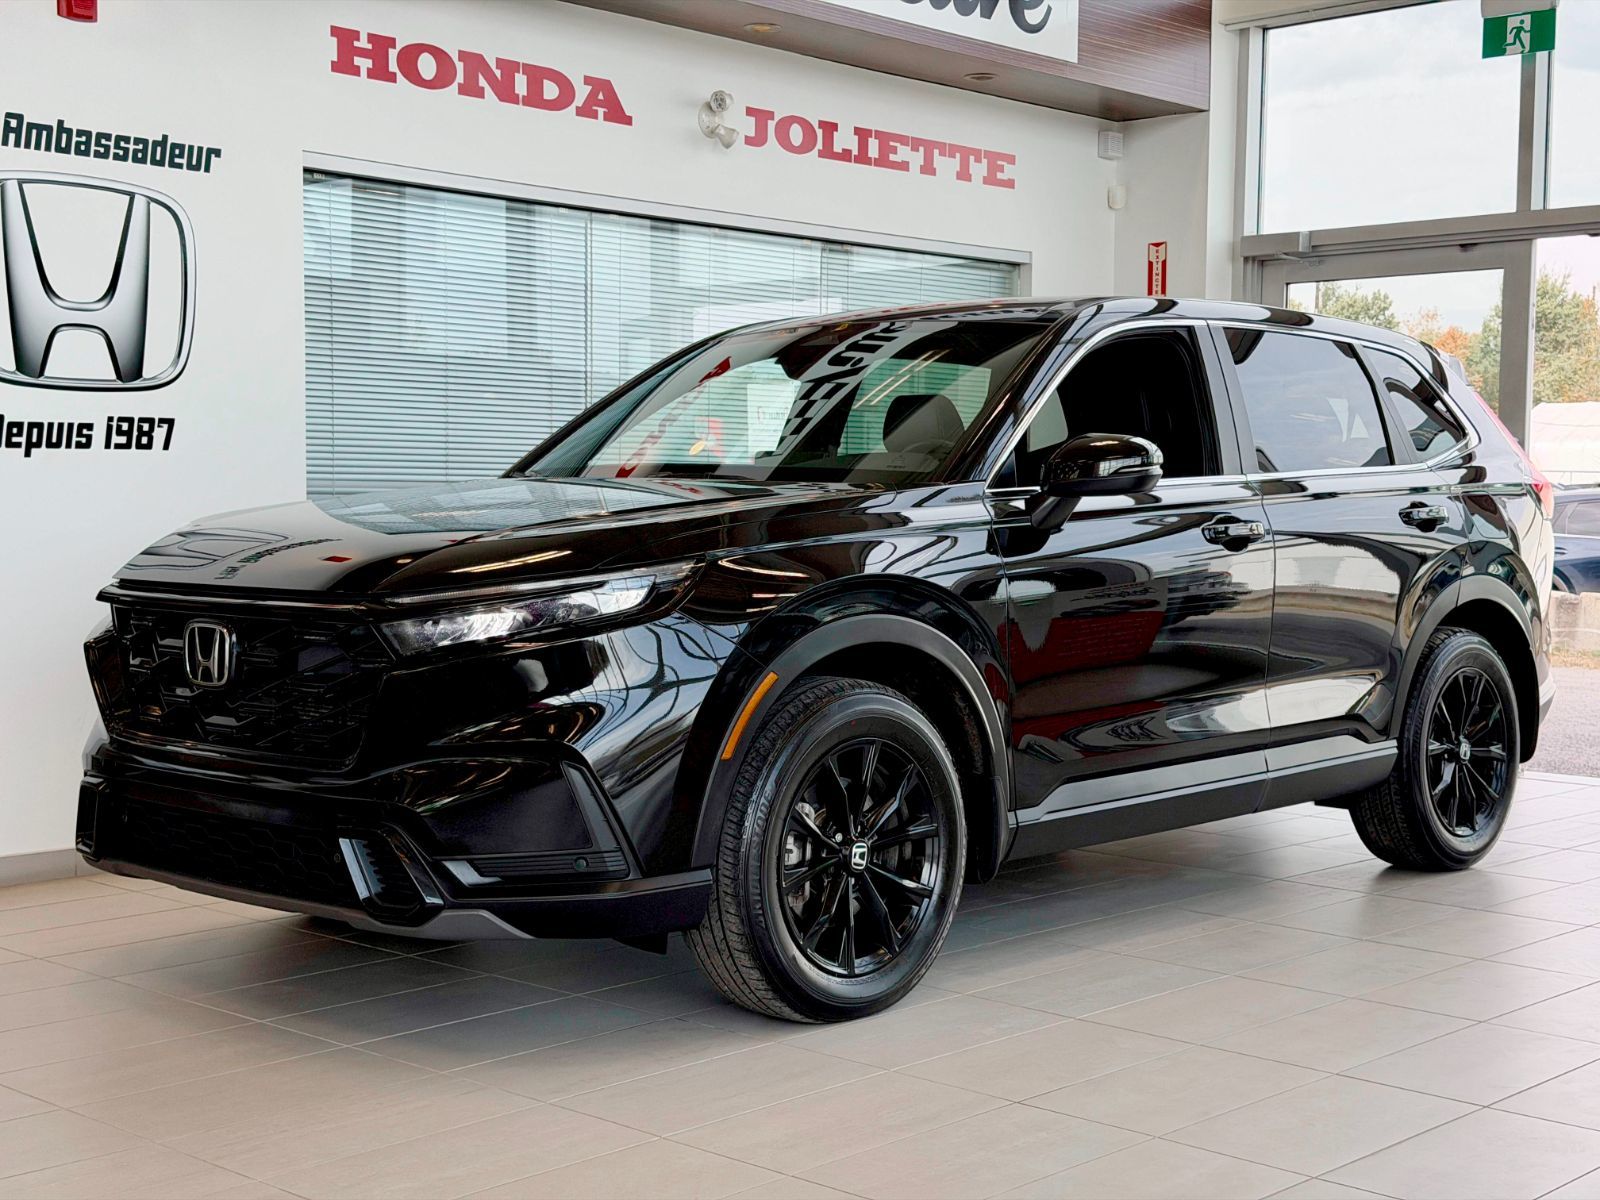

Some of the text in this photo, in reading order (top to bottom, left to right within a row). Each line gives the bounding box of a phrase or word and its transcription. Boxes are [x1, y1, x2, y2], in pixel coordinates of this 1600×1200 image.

[331, 26, 632, 126] HONDA
[1, 112, 222, 173] Ambassadeur
[745, 107, 1015, 188] JOLIETTE
[0, 414, 94, 457] epuis
